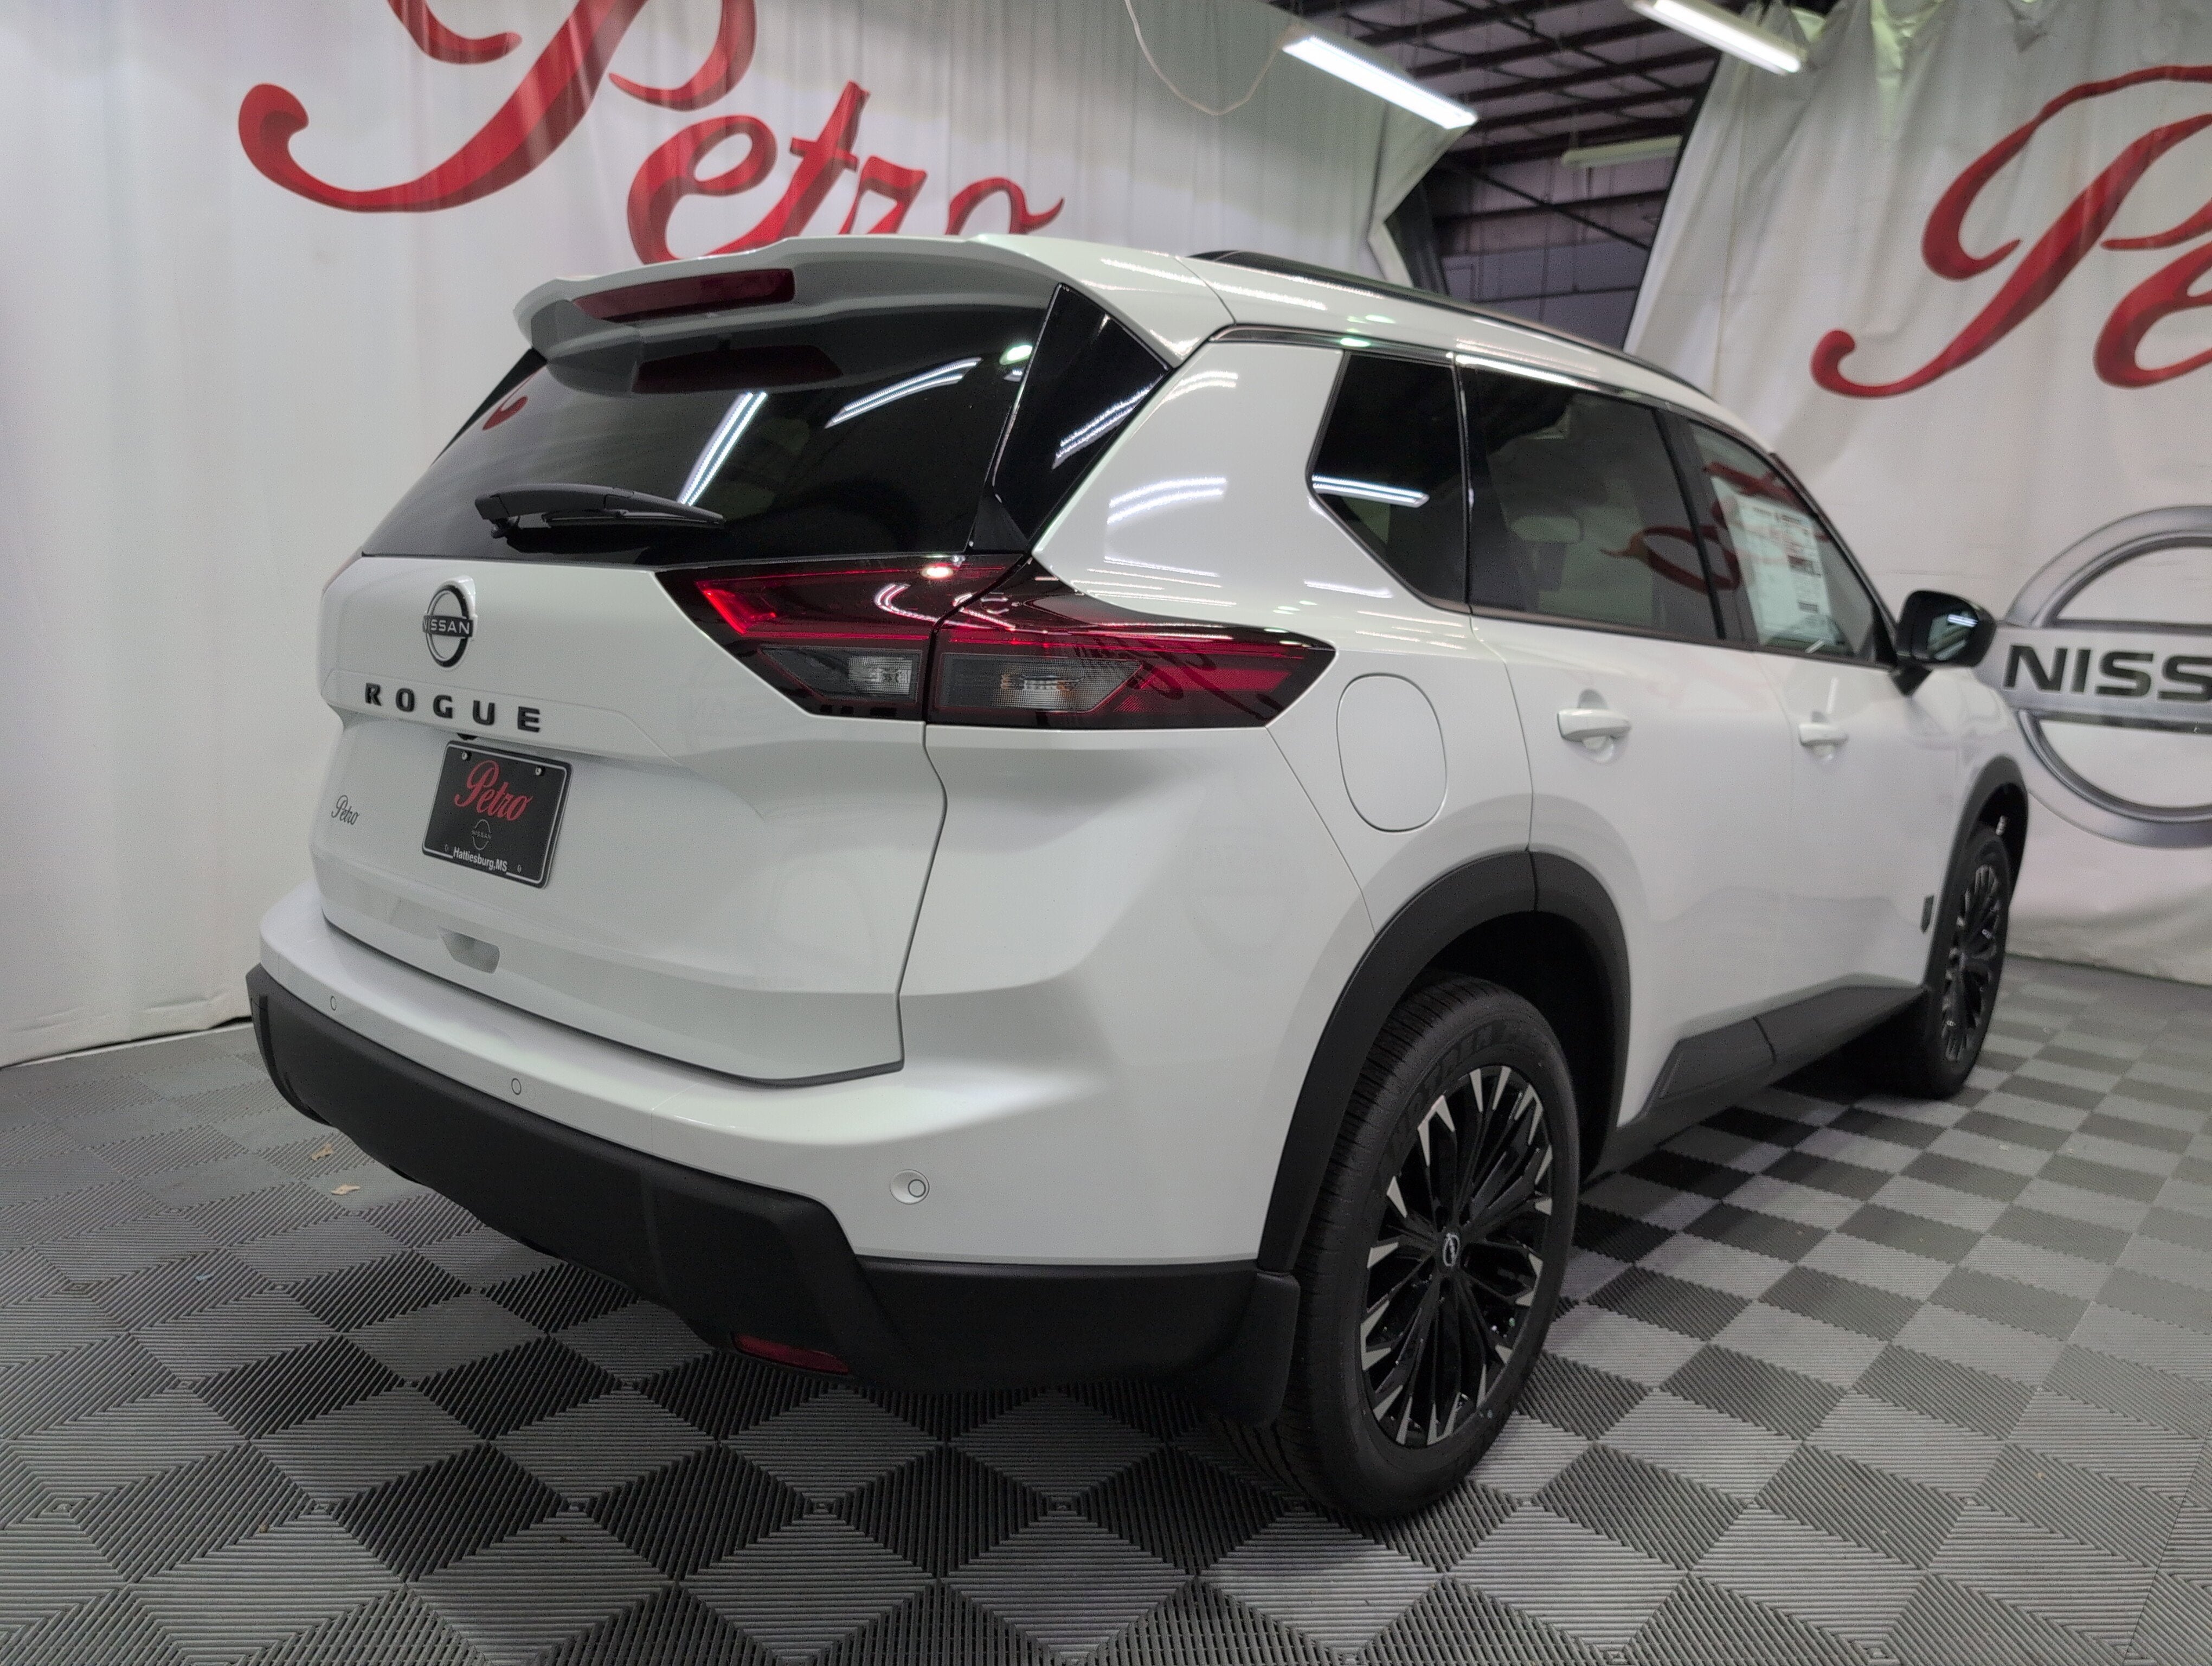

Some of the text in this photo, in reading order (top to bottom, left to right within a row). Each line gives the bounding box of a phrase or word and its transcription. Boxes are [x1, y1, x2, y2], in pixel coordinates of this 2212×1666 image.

[423, 617, 470, 635] NISSAN
[364, 682, 541, 733] ROGUE
[331, 794, 360, 825] Petro
[454, 760, 533, 821] Petro
